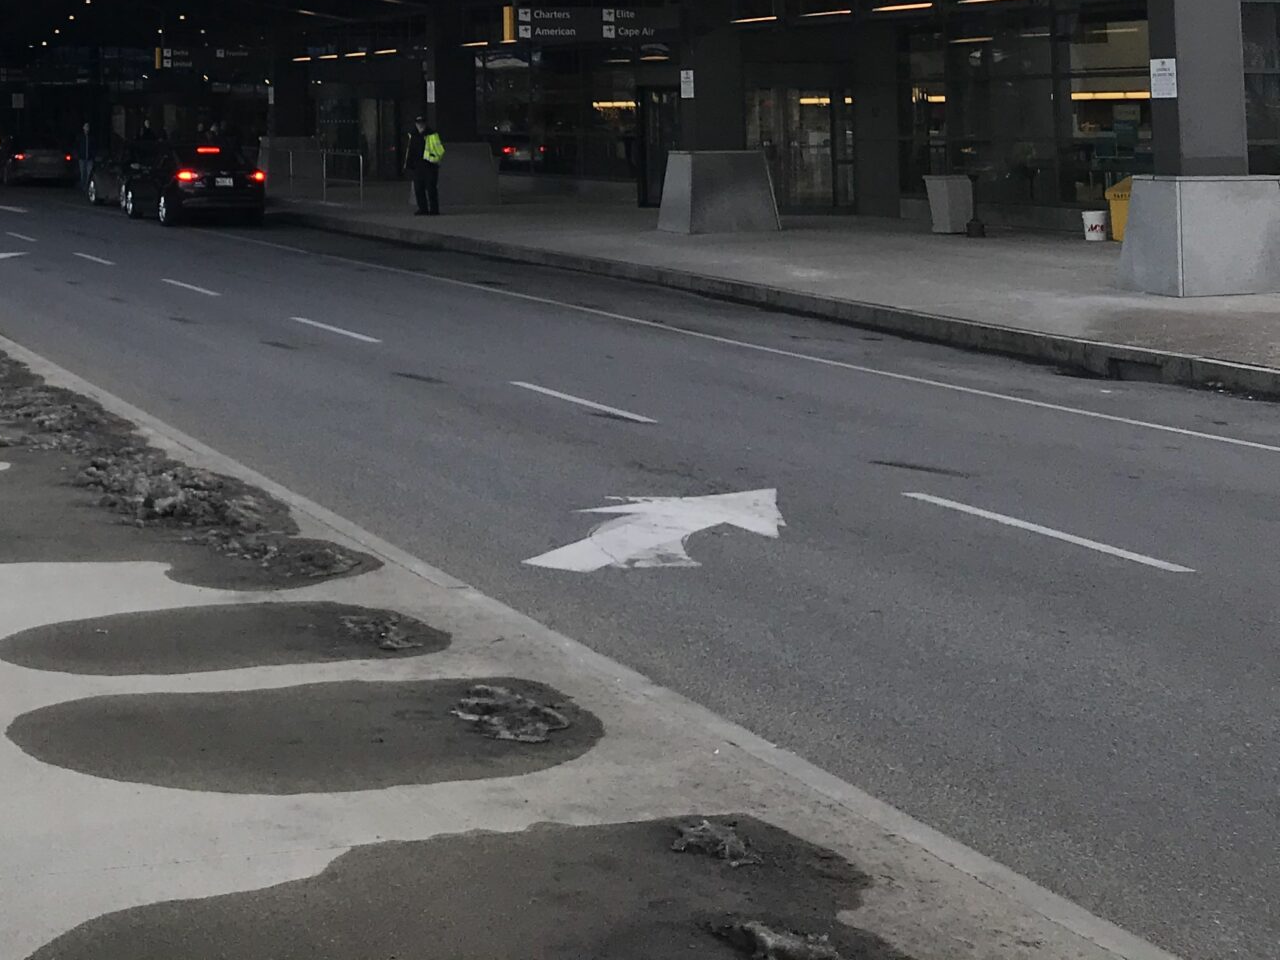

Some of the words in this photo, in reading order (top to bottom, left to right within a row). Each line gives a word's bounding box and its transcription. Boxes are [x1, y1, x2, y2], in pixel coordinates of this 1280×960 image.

[533, 9, 571, 19] Charters
[616, 9, 635, 19] Elite
[534, 27, 576, 36] American
[618, 27, 640, 38] Cape
[641, 27, 655, 36] Air
